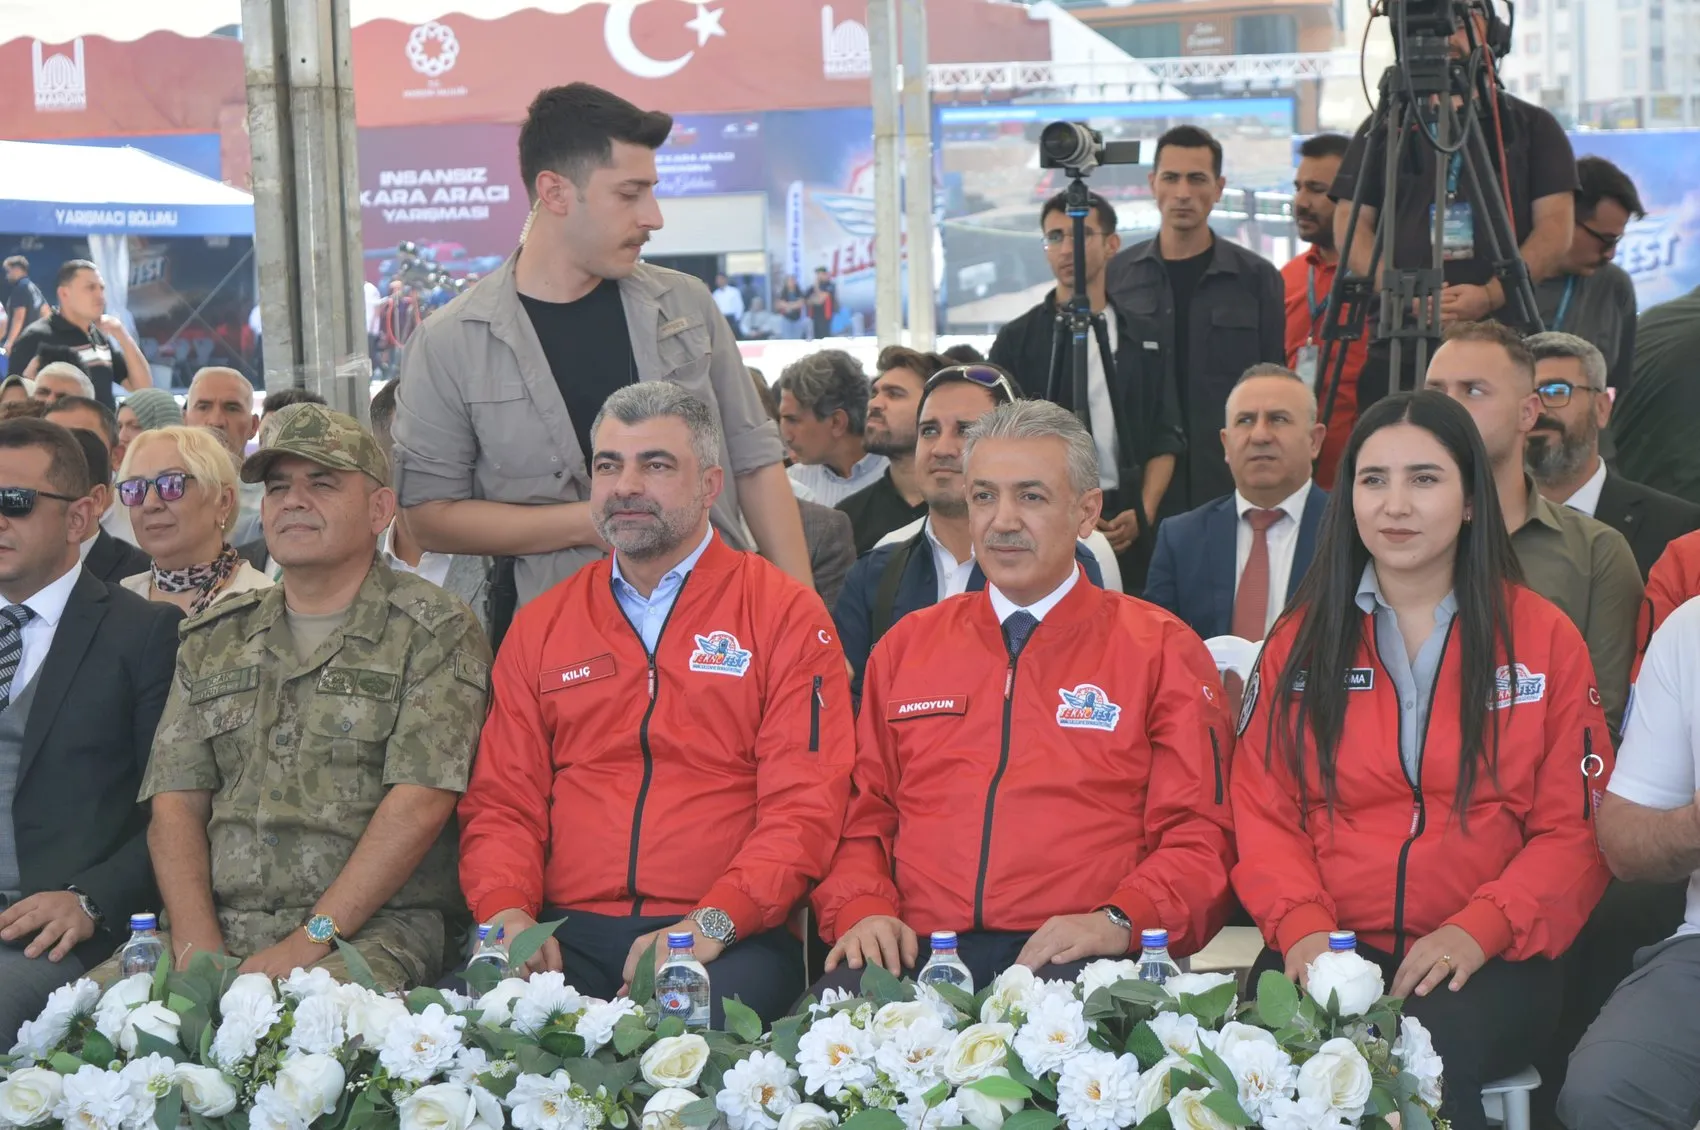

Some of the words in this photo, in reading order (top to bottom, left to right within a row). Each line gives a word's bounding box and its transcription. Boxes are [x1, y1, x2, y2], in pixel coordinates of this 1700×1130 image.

[359, 187, 427, 207] KARA
[430, 184, 510, 205] ARACI
[562, 665, 591, 683] KILIÇ
[898, 699, 955, 714] AKKOYUN
[1060, 706, 1117, 723] TEKNOFEST
